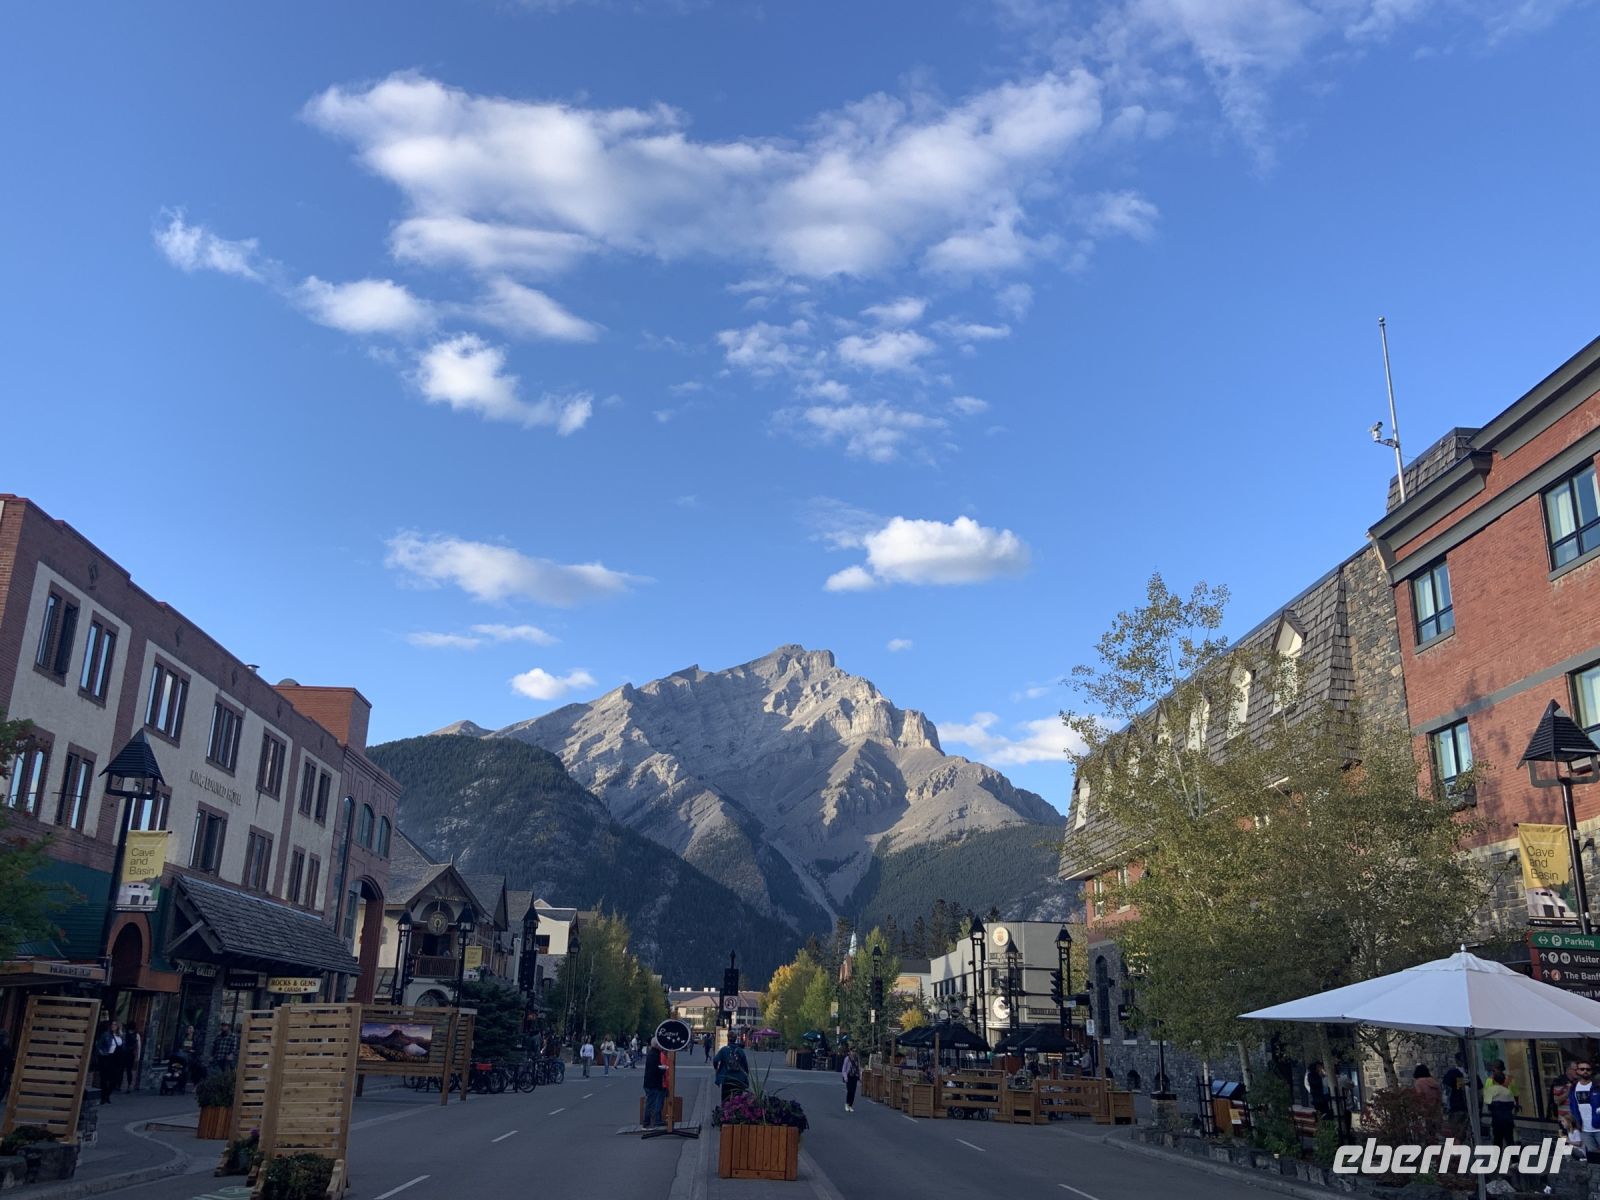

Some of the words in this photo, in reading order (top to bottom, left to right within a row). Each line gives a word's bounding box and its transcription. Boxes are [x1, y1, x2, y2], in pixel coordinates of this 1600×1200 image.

[132, 848, 155, 857] Cave
[1526, 845, 1555, 858] Cave
[130, 857, 148, 865] and
[1529, 858, 1548, 868] and
[128, 866, 154, 875] Basin
[1531, 868, 1559, 881] Basin
[1564, 937, 1595, 948] Parking
[1573, 954, 1600, 964] Visitor
[1564, 971, 1579, 980] The
[300, 979, 317, 987] GEMS
